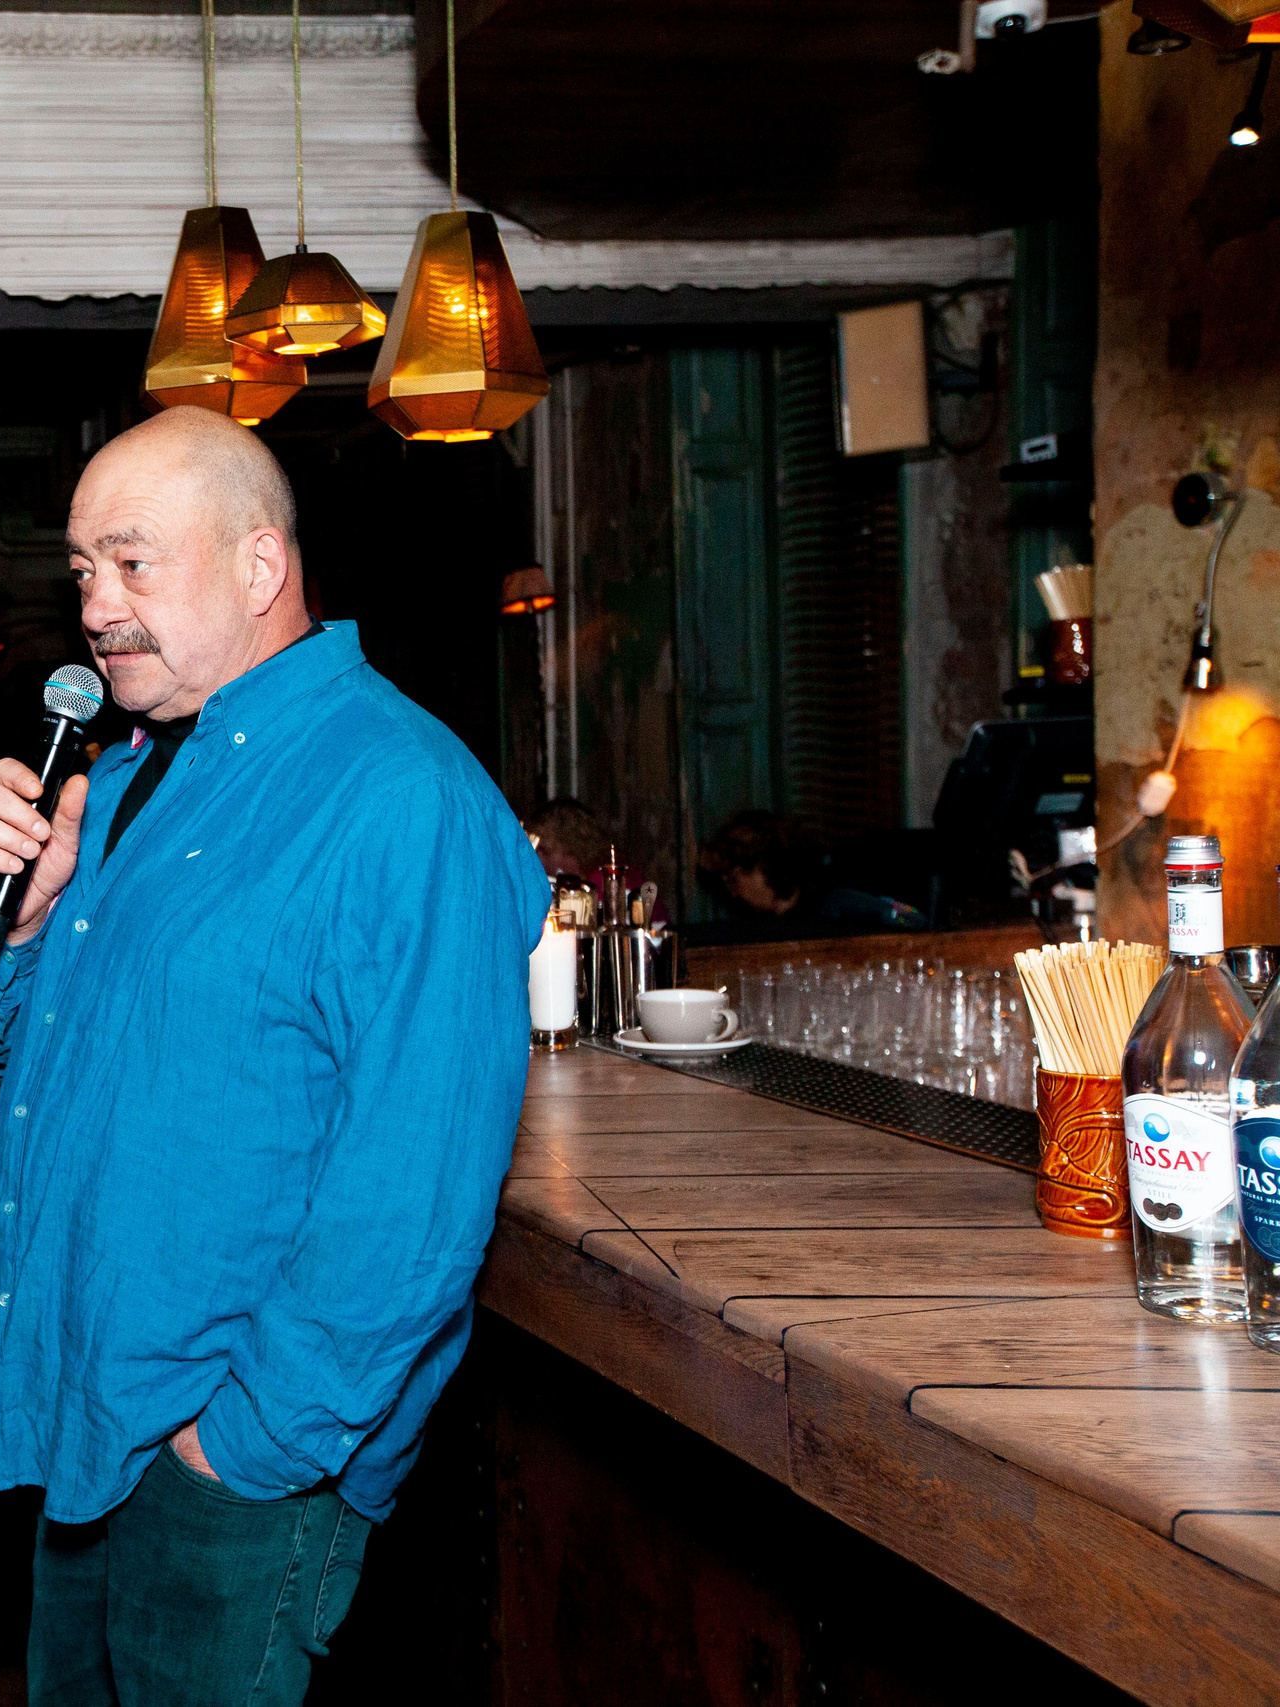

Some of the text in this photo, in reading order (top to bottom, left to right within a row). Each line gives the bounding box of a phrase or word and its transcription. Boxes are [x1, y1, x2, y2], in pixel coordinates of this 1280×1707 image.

[1169, 927, 1199, 936] TASSAY
[1126, 1138, 1211, 1172] TASSAY
[1237, 1163, 1280, 1195] TAS
[1147, 1188, 1171, 1199] STILL
[1240, 1189, 1263, 1201] NATURAL
